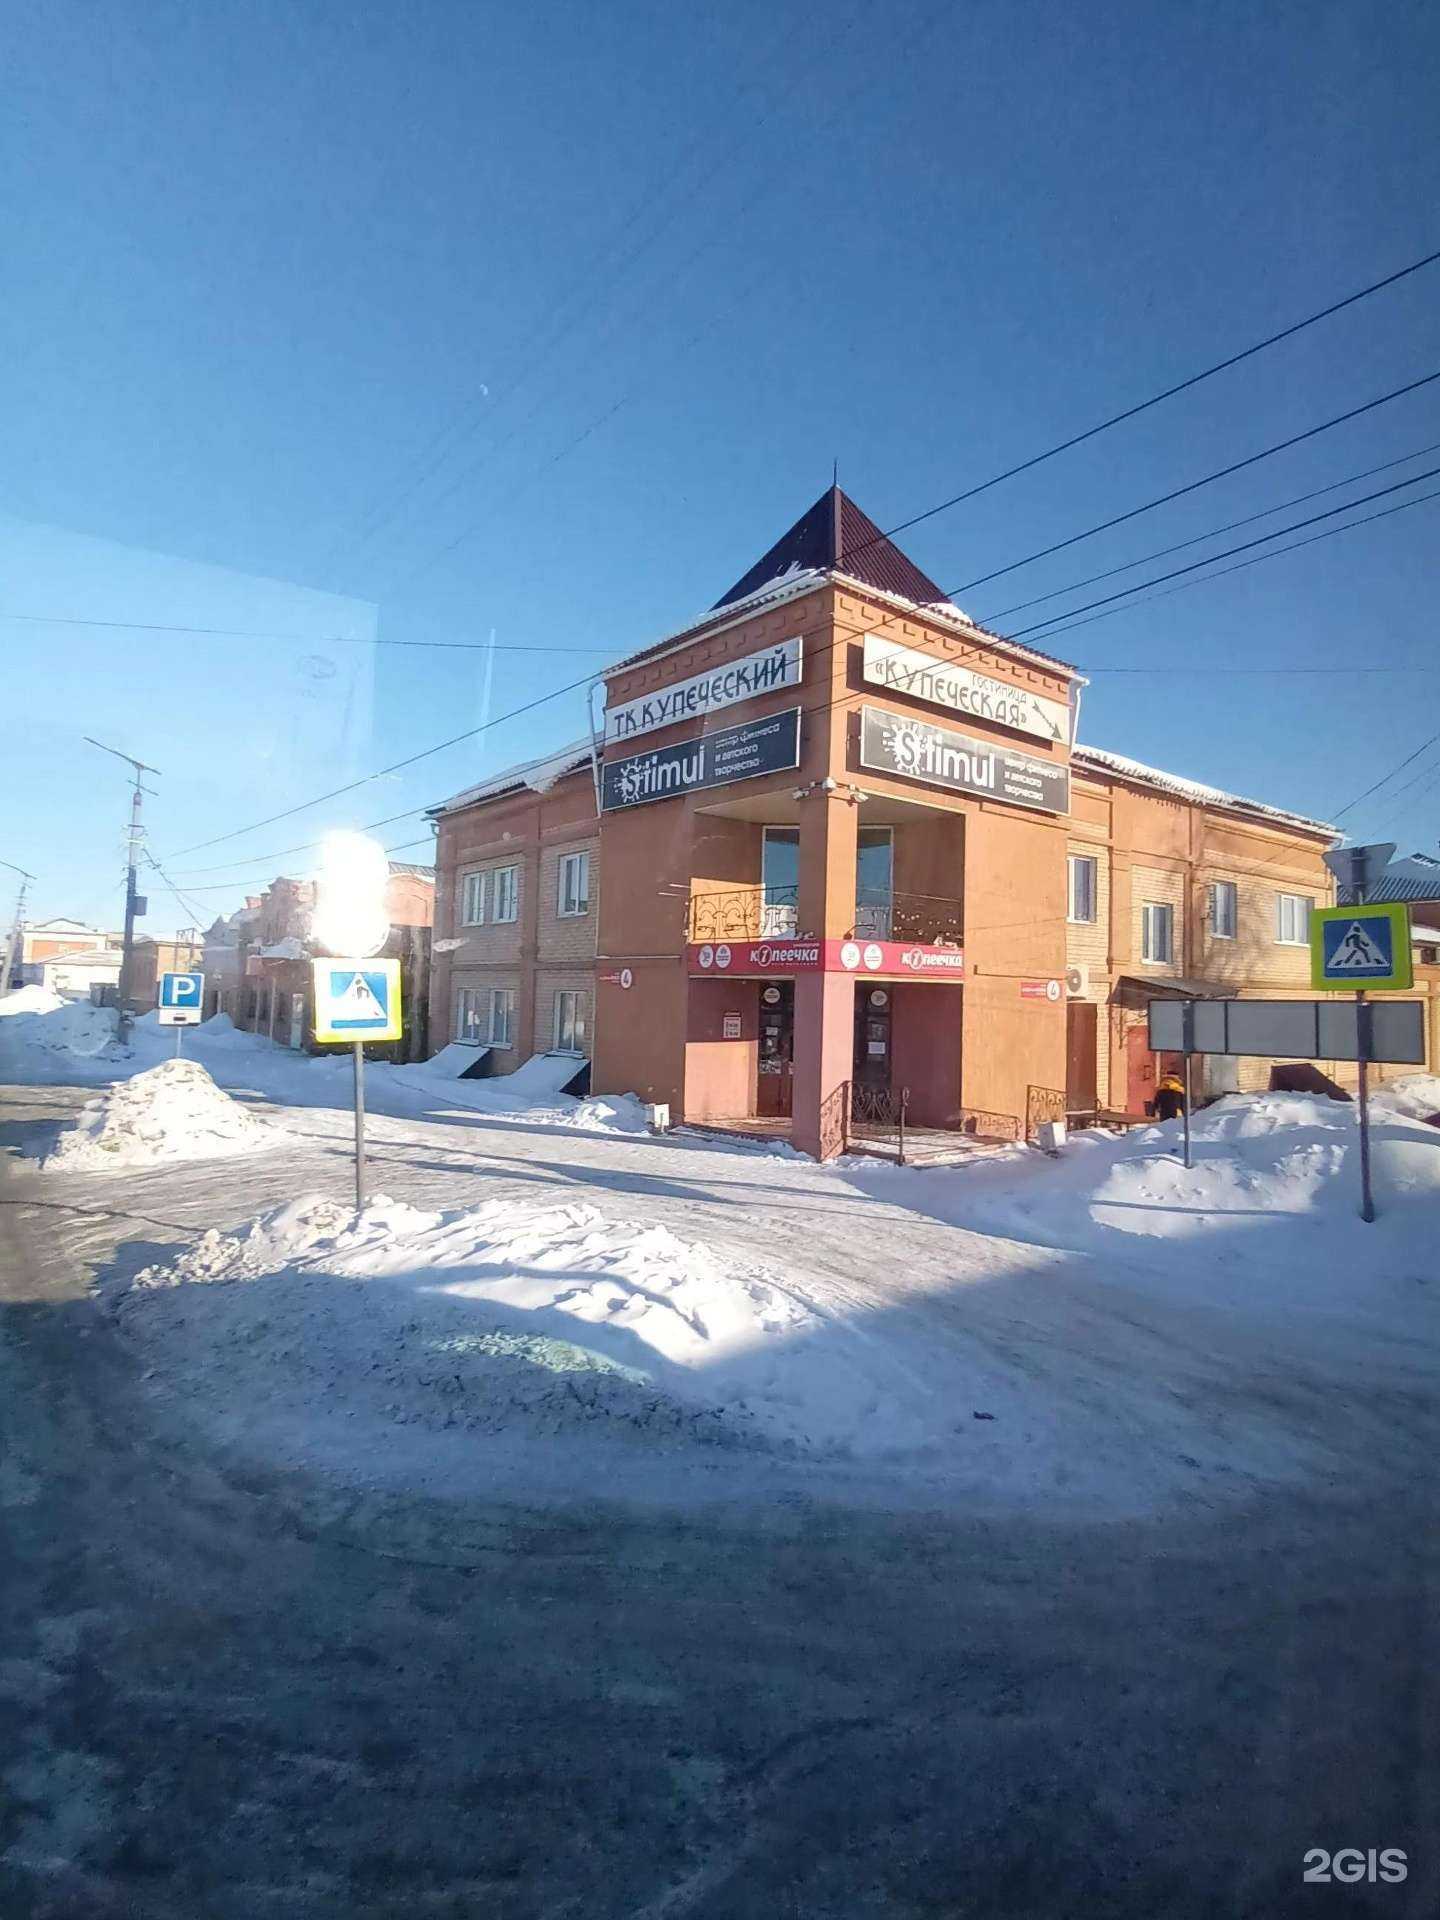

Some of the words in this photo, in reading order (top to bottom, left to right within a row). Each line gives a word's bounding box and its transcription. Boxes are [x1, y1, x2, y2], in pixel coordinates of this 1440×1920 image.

[614, 708, 637, 738] ТК
[641, 647, 787, 728] КУПЕЧЕСКИЙ
[622, 745, 705, 799] Stimul
[898, 729, 996, 789] Stimul
[171, 976, 196, 1004] P
